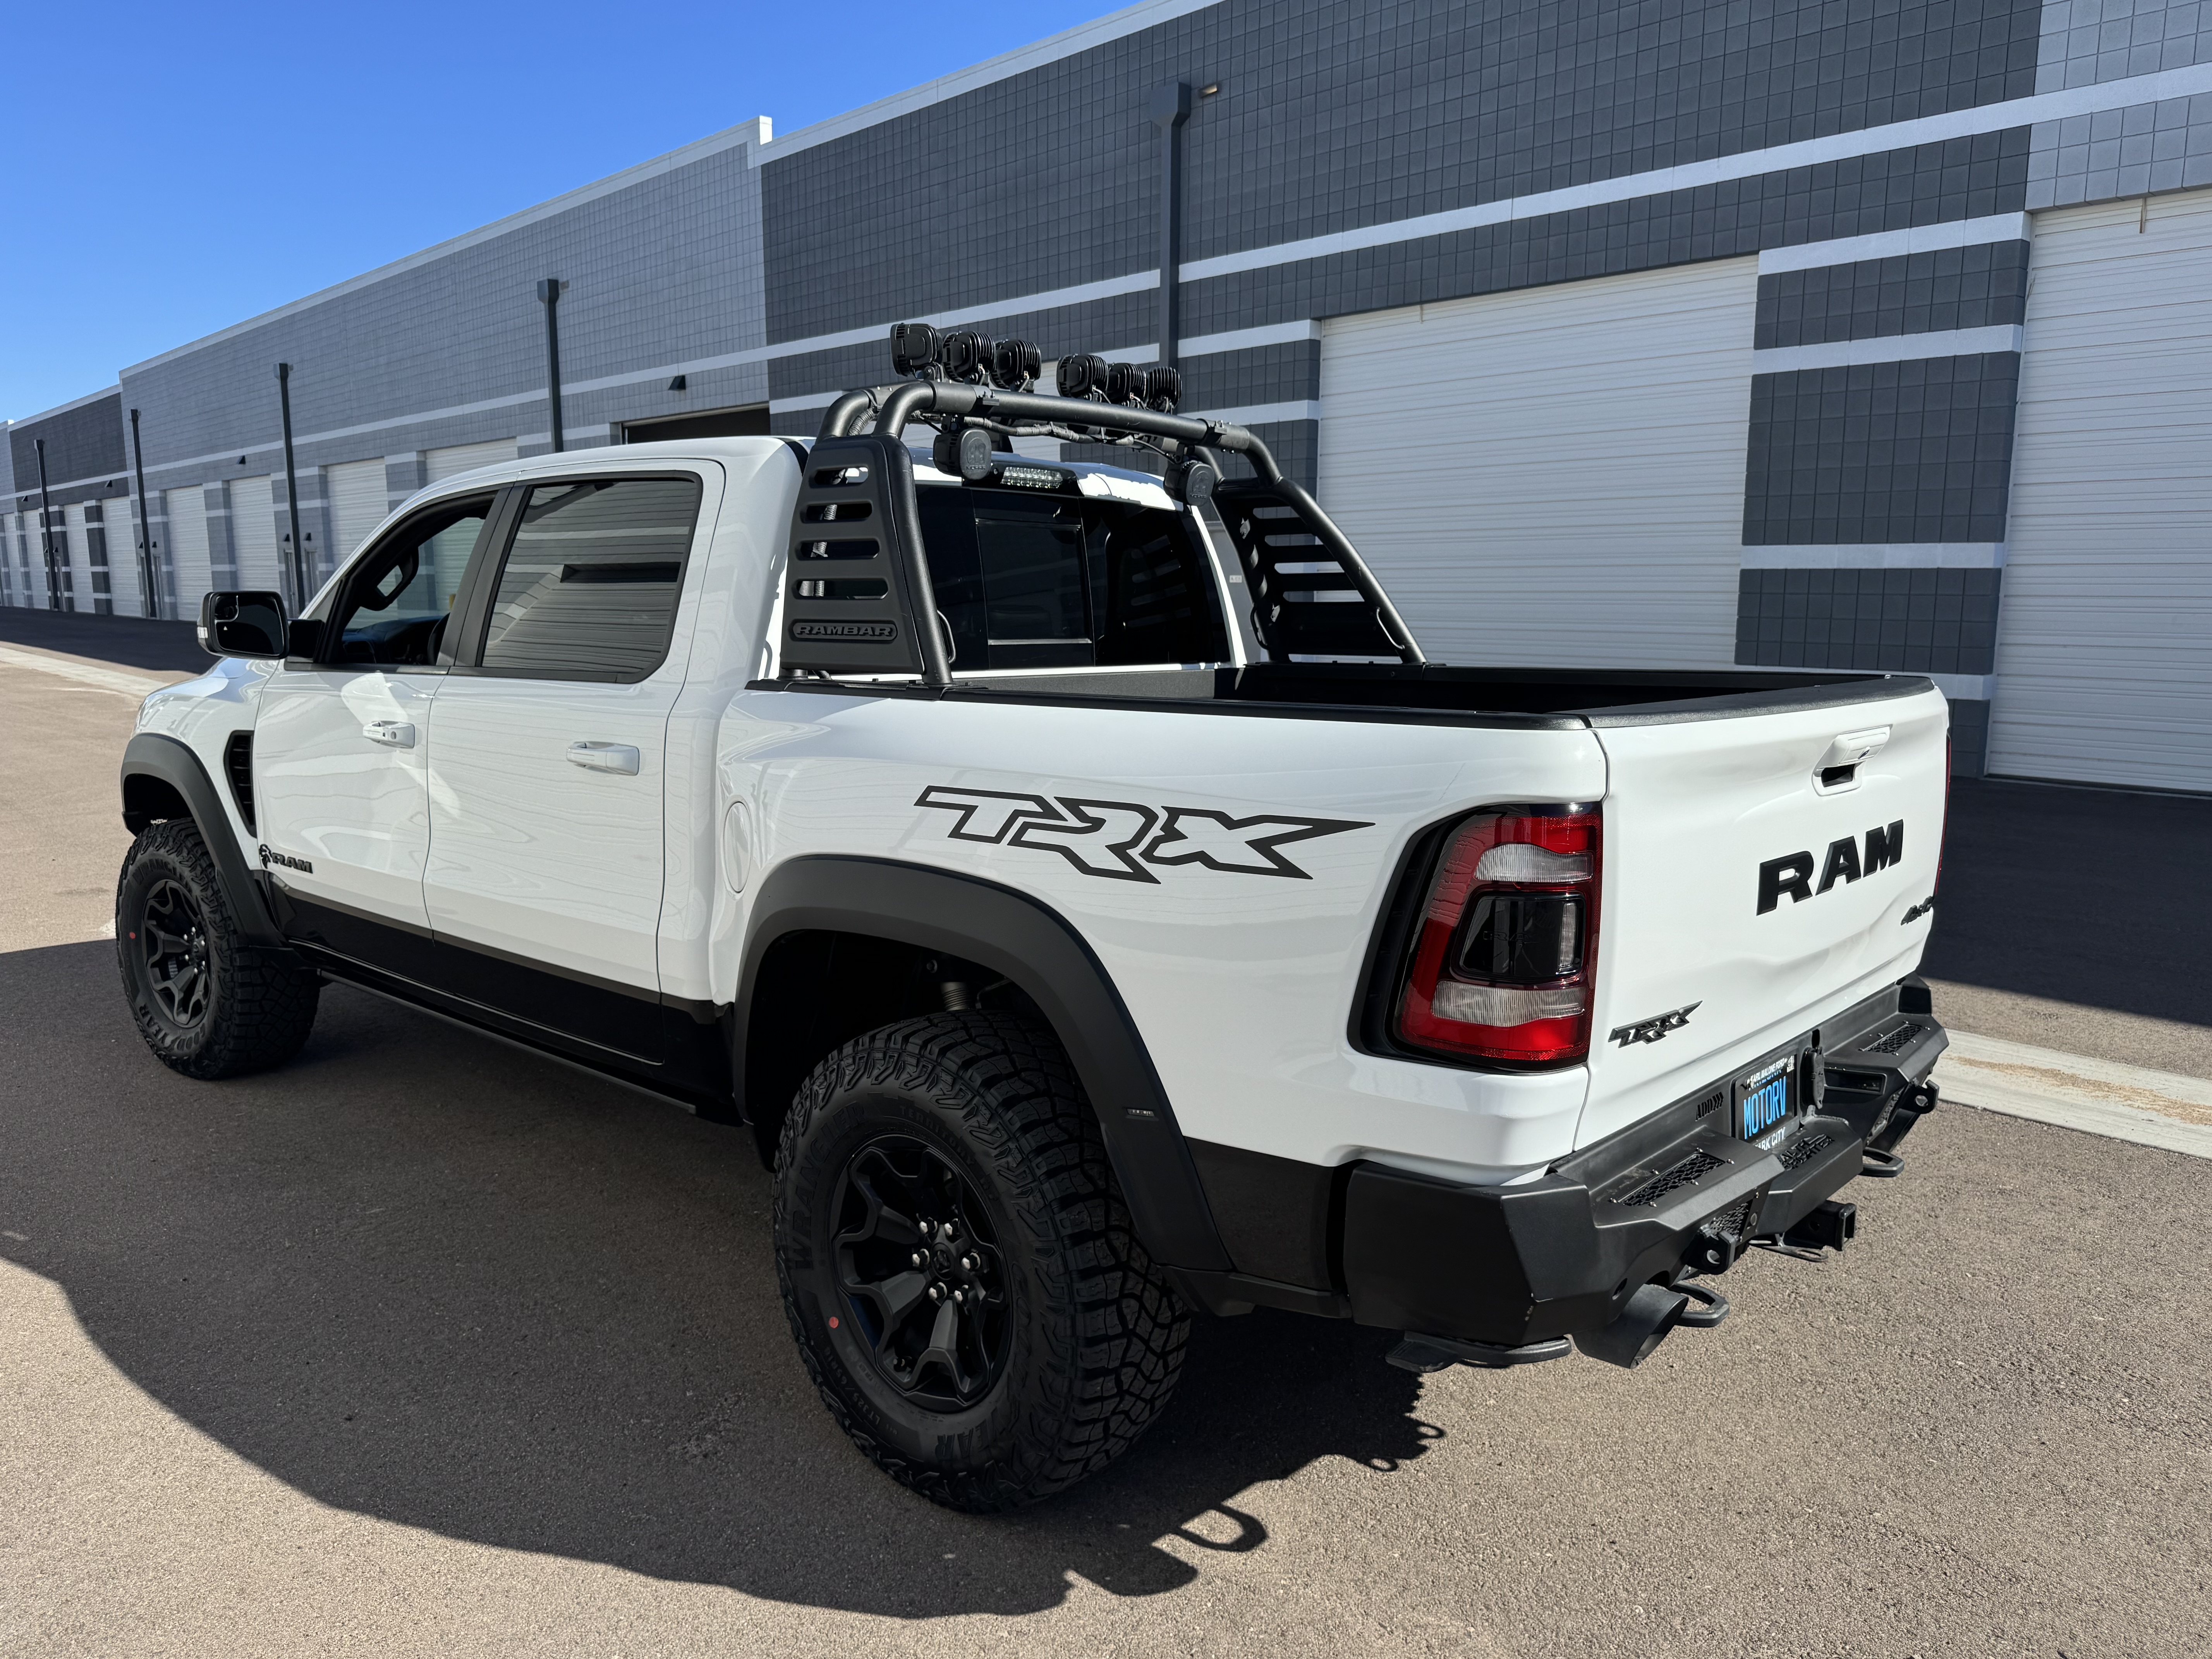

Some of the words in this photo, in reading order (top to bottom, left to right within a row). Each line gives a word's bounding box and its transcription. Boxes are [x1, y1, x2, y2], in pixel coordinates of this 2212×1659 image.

[796, 625, 893, 637] RAMBAR
[271, 852, 313, 874] RAM
[914, 785, 1376, 884] TRX
[1756, 819, 1903, 916] RAM
[1608, 1000, 1702, 1048] TRX
[900, 1104, 975, 1165] TERRITORY
[1743, 1075, 1786, 1140] MOTORV
[1755, 1138, 1771, 1151] ARK
[793, 1101, 865, 1270] WRANGLER
